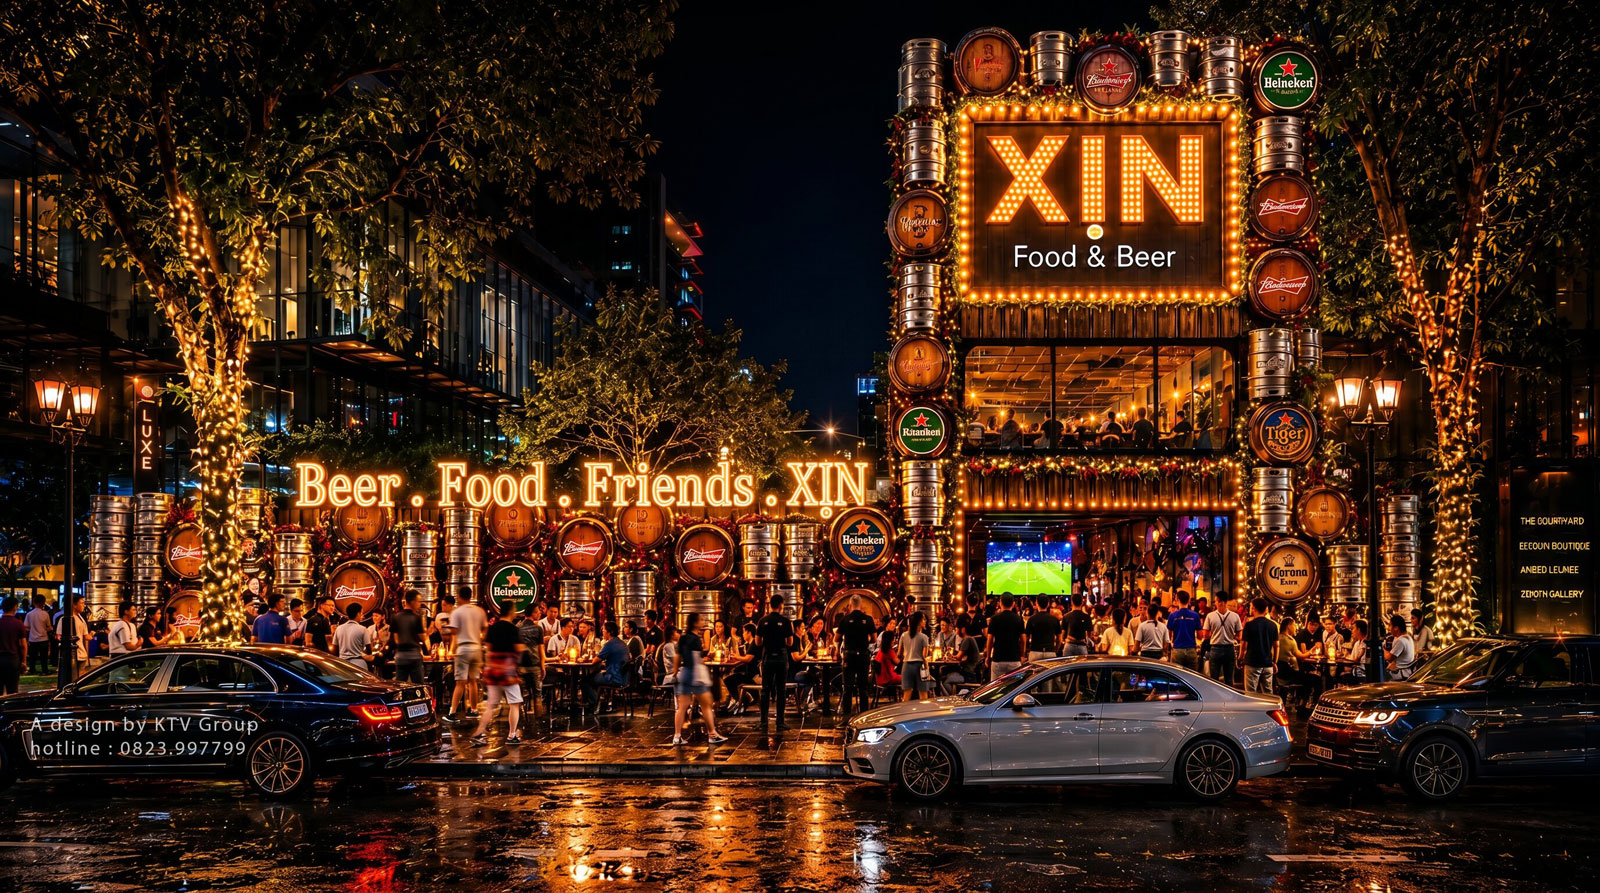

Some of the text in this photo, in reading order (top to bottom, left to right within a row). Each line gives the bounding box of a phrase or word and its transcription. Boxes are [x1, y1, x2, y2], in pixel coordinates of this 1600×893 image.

[1263, 76, 1314, 89] Heineken
[1013, 244, 1176, 268] Food & Beer
[141, 409, 153, 470] LUXE
[1265, 426, 1304, 445] Tiger
[295, 462, 401, 507] Beer
[438, 461, 548, 507] Food
[584, 461, 754, 507] Friends
[1520, 516, 1536, 525] THE
[842, 534, 886, 545] Heineken
[1268, 566, 1308, 580] Corona
[1549, 589, 1584, 599] GALLERY
